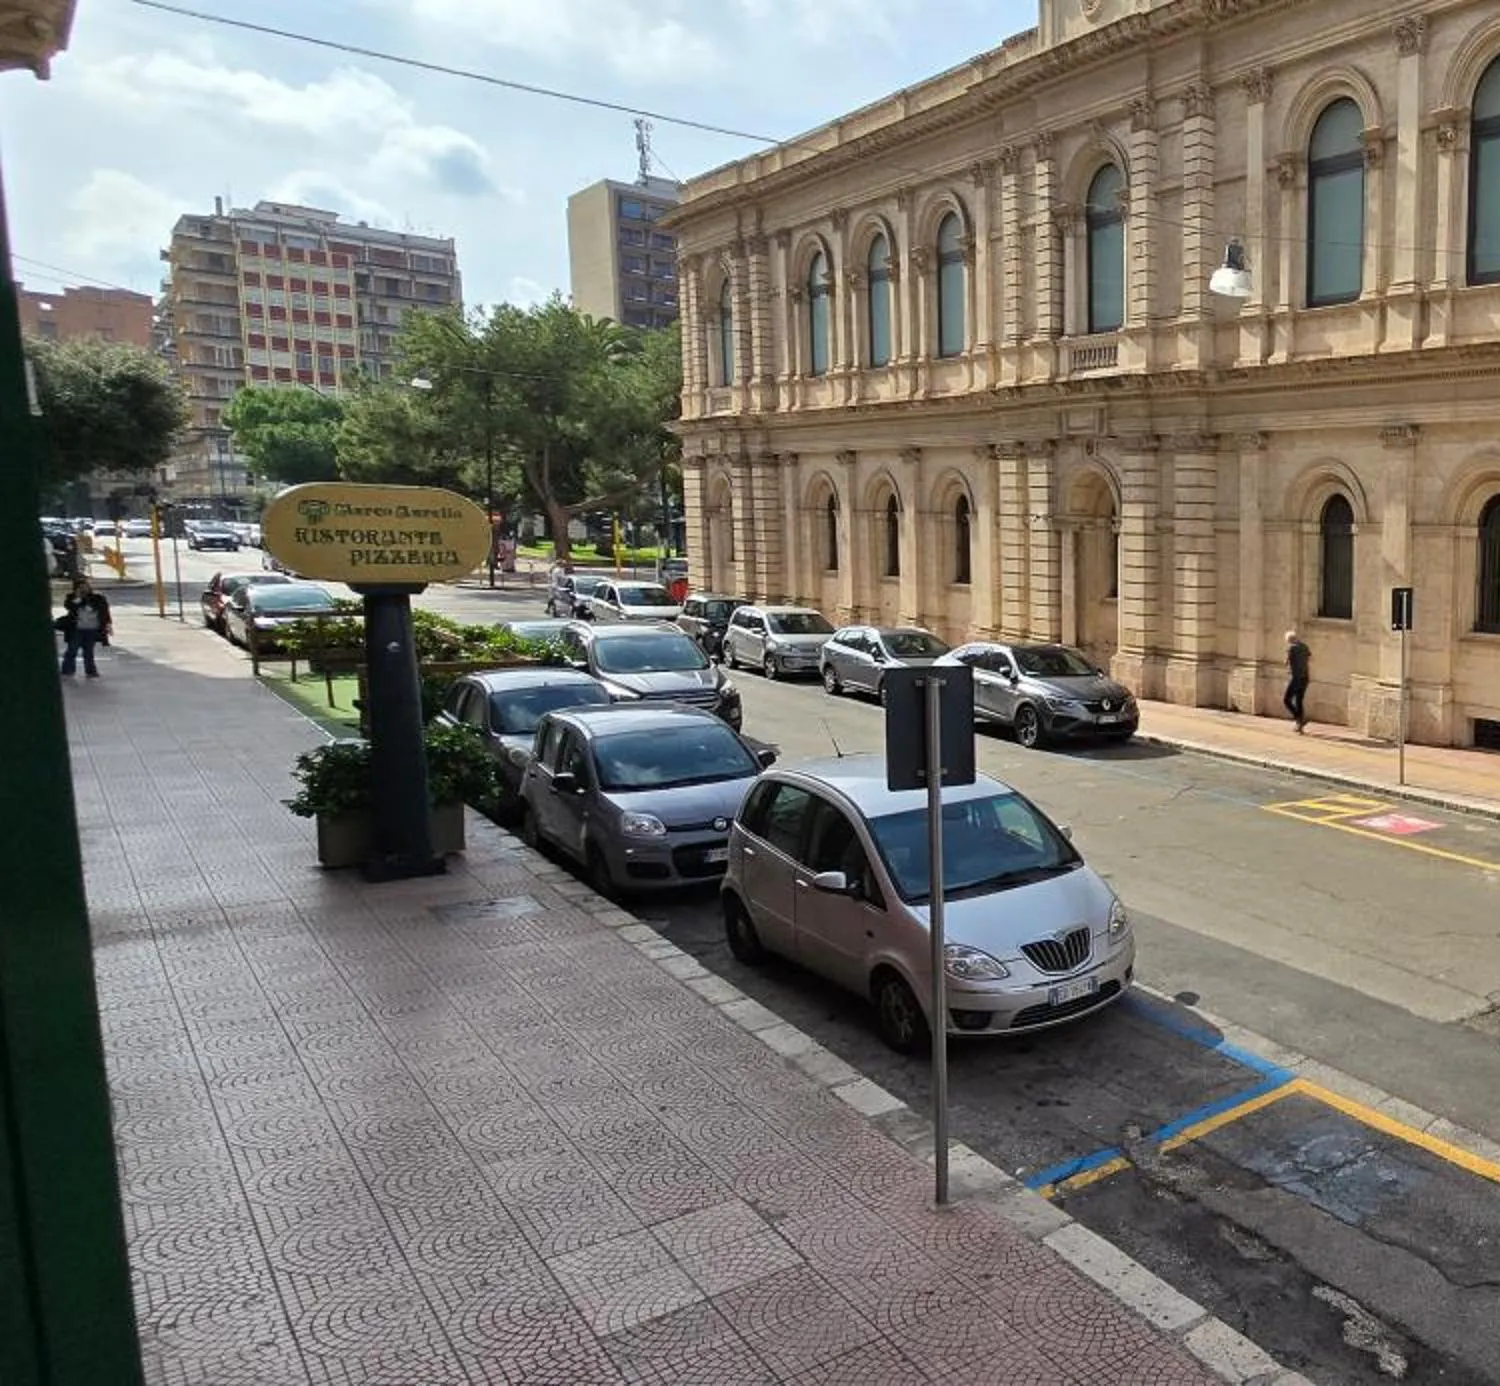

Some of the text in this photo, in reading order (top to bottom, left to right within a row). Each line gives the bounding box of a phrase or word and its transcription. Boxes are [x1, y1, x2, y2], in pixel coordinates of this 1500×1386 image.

[395, 505, 463, 519] Aurelio
[295, 528, 443, 546] RISTORANTE
[350, 549, 460, 566] PIZZERIA
